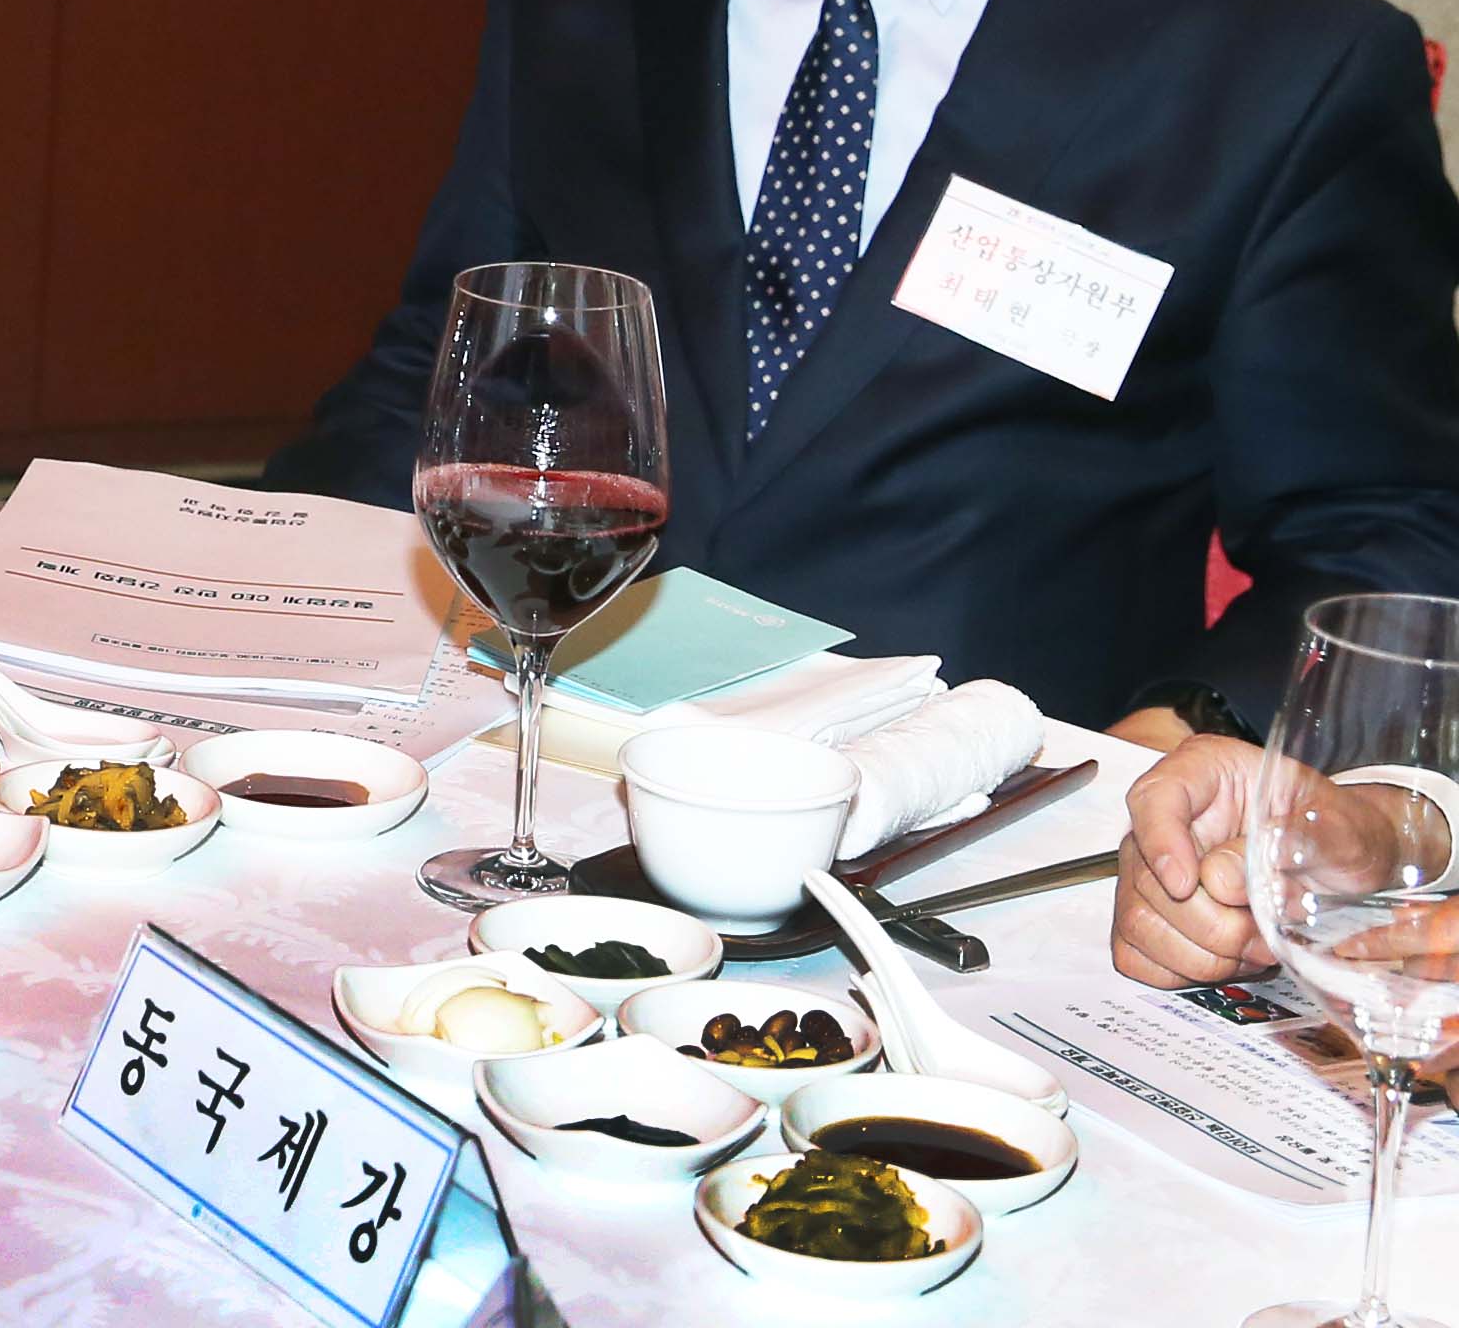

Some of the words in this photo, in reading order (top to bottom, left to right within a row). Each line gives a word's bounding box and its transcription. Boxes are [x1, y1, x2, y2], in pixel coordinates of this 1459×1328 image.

[948, 224, 1137, 320] 산업통상자원부
[230, 591, 270, 603] CEO
[119, 998, 407, 1264] 동국제강
